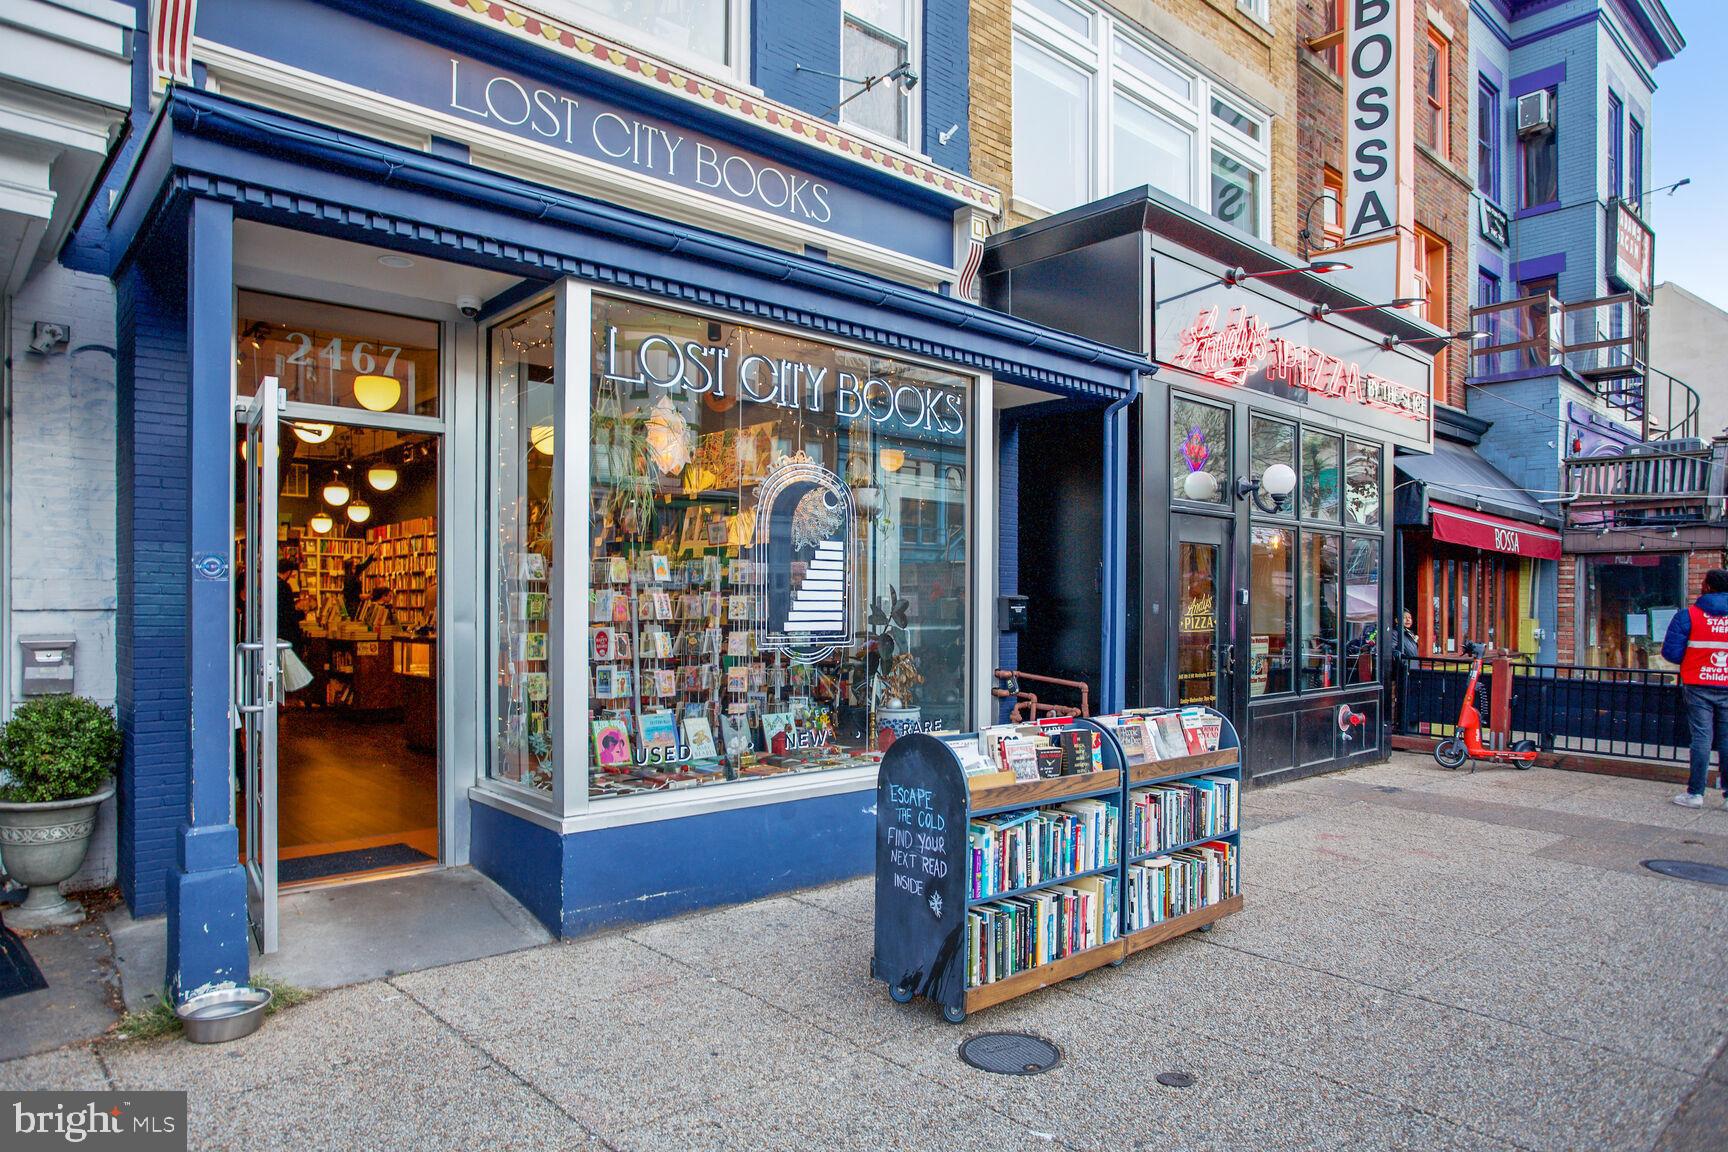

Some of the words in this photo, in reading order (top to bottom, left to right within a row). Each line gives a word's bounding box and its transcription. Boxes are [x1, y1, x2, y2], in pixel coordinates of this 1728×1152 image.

[1350, 0, 1392, 235] BOSSA
[450, 59, 579, 144] LOST
[592, 113, 684, 176] CITY
[695, 142, 832, 223] BOOKS
[286, 332, 402, 377] 2467
[1180, 304, 1269, 384] Andy's
[1276, 337, 1364, 402] PIZZA
[1367, 379, 1380, 399] BY
[1382, 383, 1399, 404] THE
[1401, 391, 1426, 412] SLICE
[604, 325, 729, 397] LOST
[740, 354, 828, 413] CITY
[835, 371, 965, 435] BOOKS
[1494, 528, 1520, 553] BOSSA
[1187, 593, 1213, 616] Andy's
[1184, 616, 1214, 630] PIZZA
[636, 744, 692, 766] USED
[785, 730, 828, 751] NEW
[902, 719, 942, 735] RARE
[890, 784, 934, 811] ESCAPE
[896, 807, 912, 825] THE
[918, 810, 947, 833] COLD.
[887, 827, 913, 849] FIND
[916, 833, 947, 855] YOUR
[890, 850, 917, 869] NEXT
[922, 856, 948, 879] READ
[894, 872, 924, 896] INSIDE
